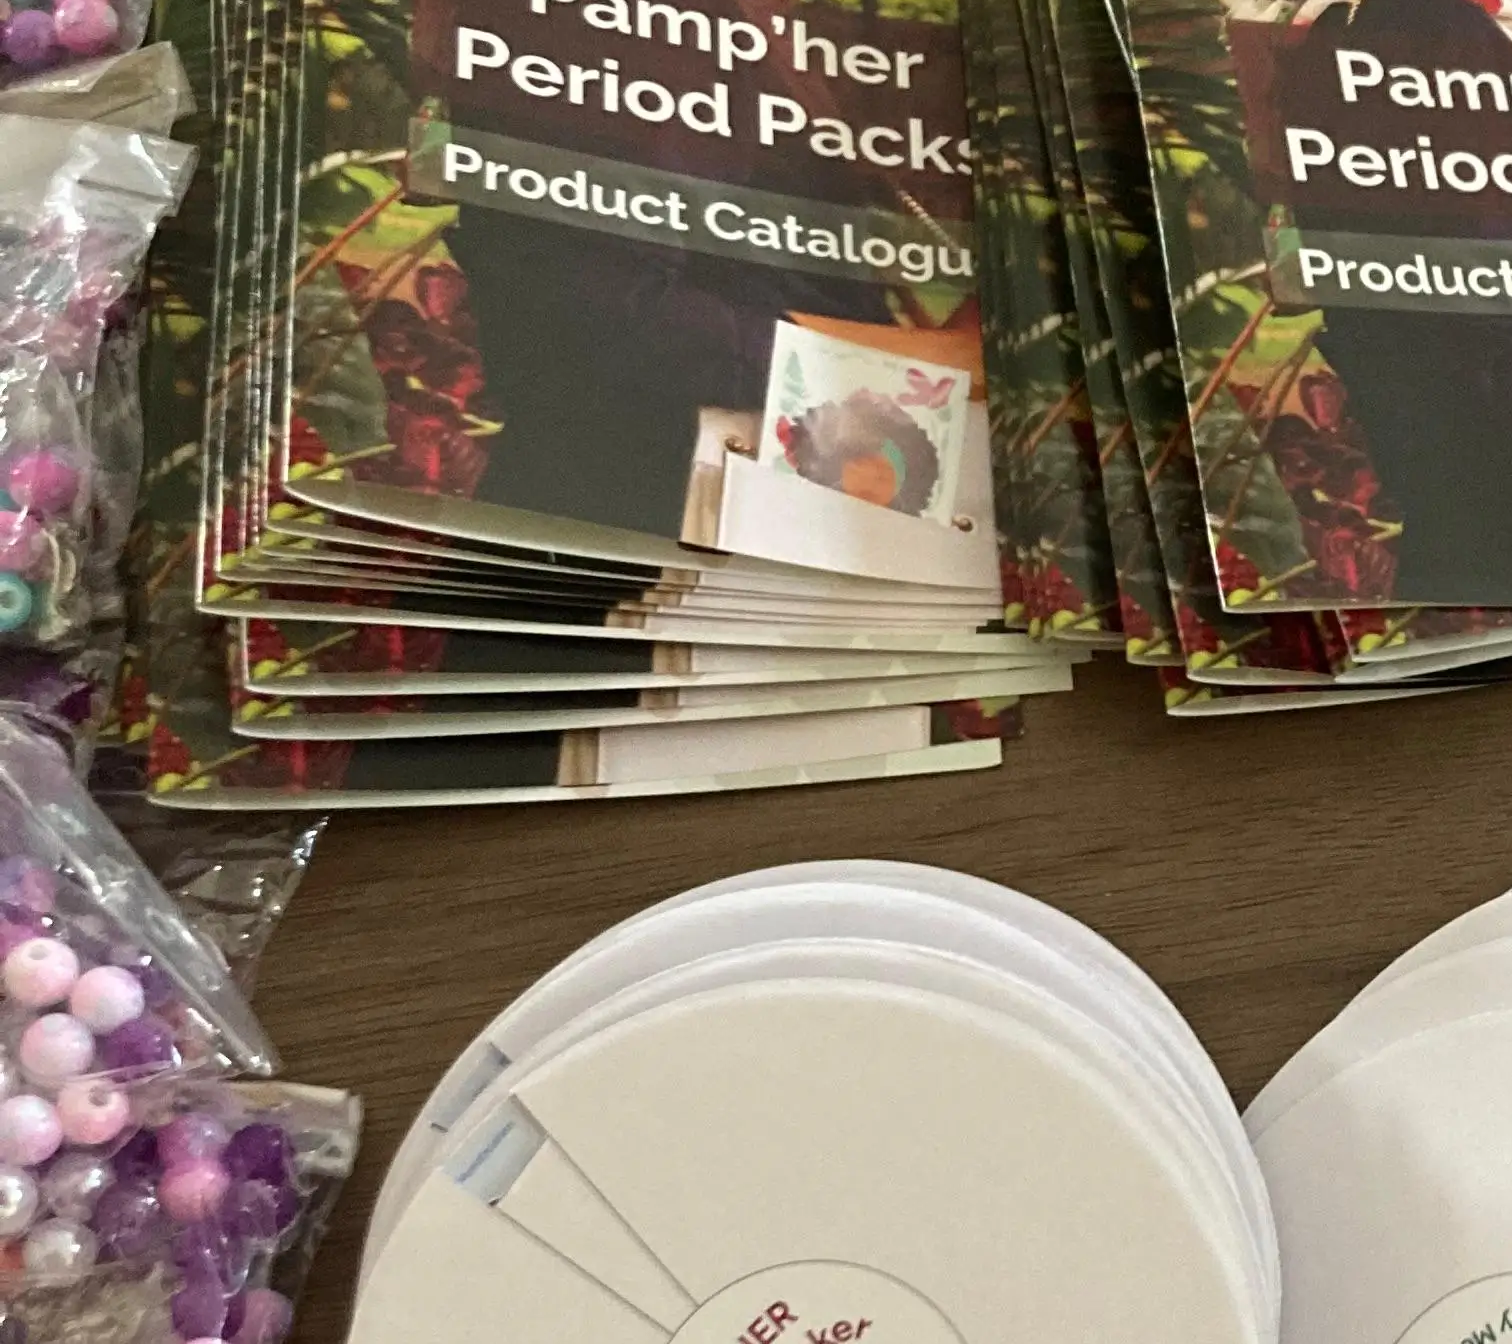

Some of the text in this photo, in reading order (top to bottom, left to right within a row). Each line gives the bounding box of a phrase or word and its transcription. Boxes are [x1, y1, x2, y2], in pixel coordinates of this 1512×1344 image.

[455, 26, 733, 137] Period
[443, 143, 974, 282] Product Catalogu
